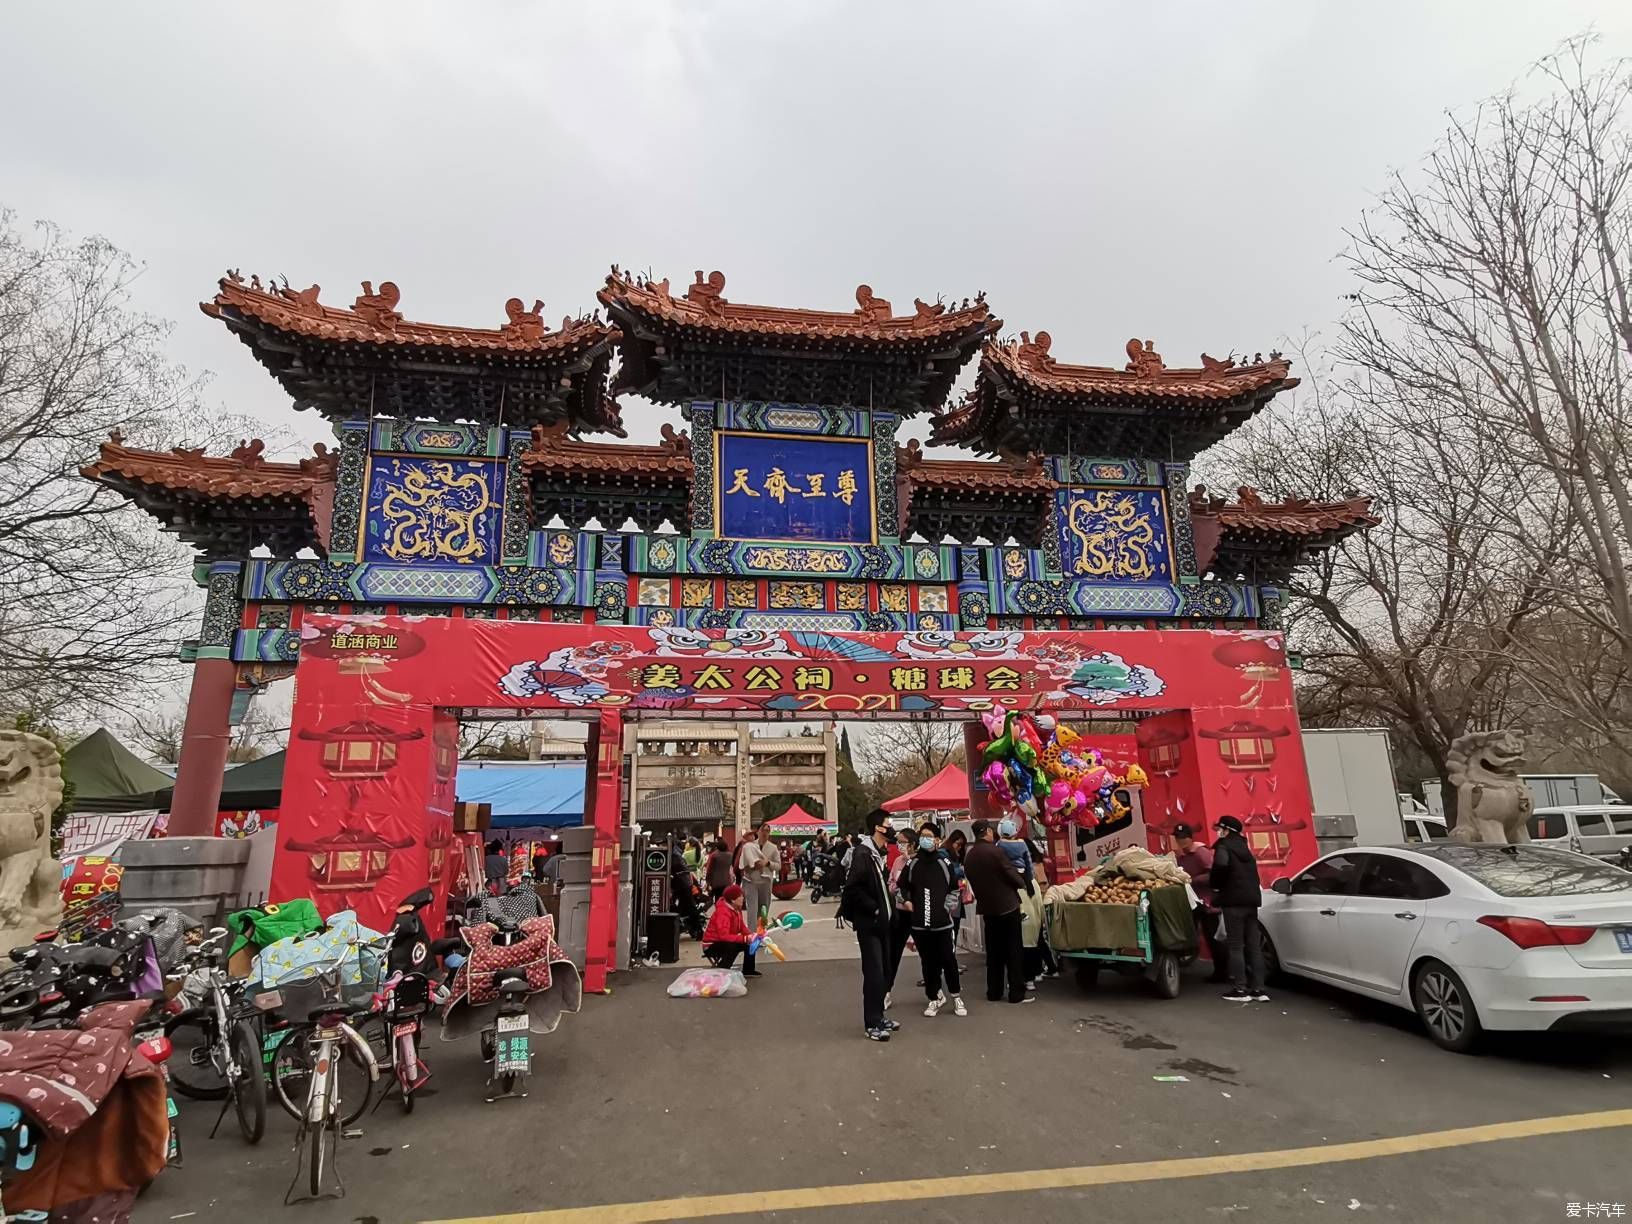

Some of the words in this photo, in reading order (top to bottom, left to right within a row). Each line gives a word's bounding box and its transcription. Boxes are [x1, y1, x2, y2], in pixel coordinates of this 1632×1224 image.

[331, 633, 398, 649] 道涵商业
[797, 693, 896, 711] 2021
